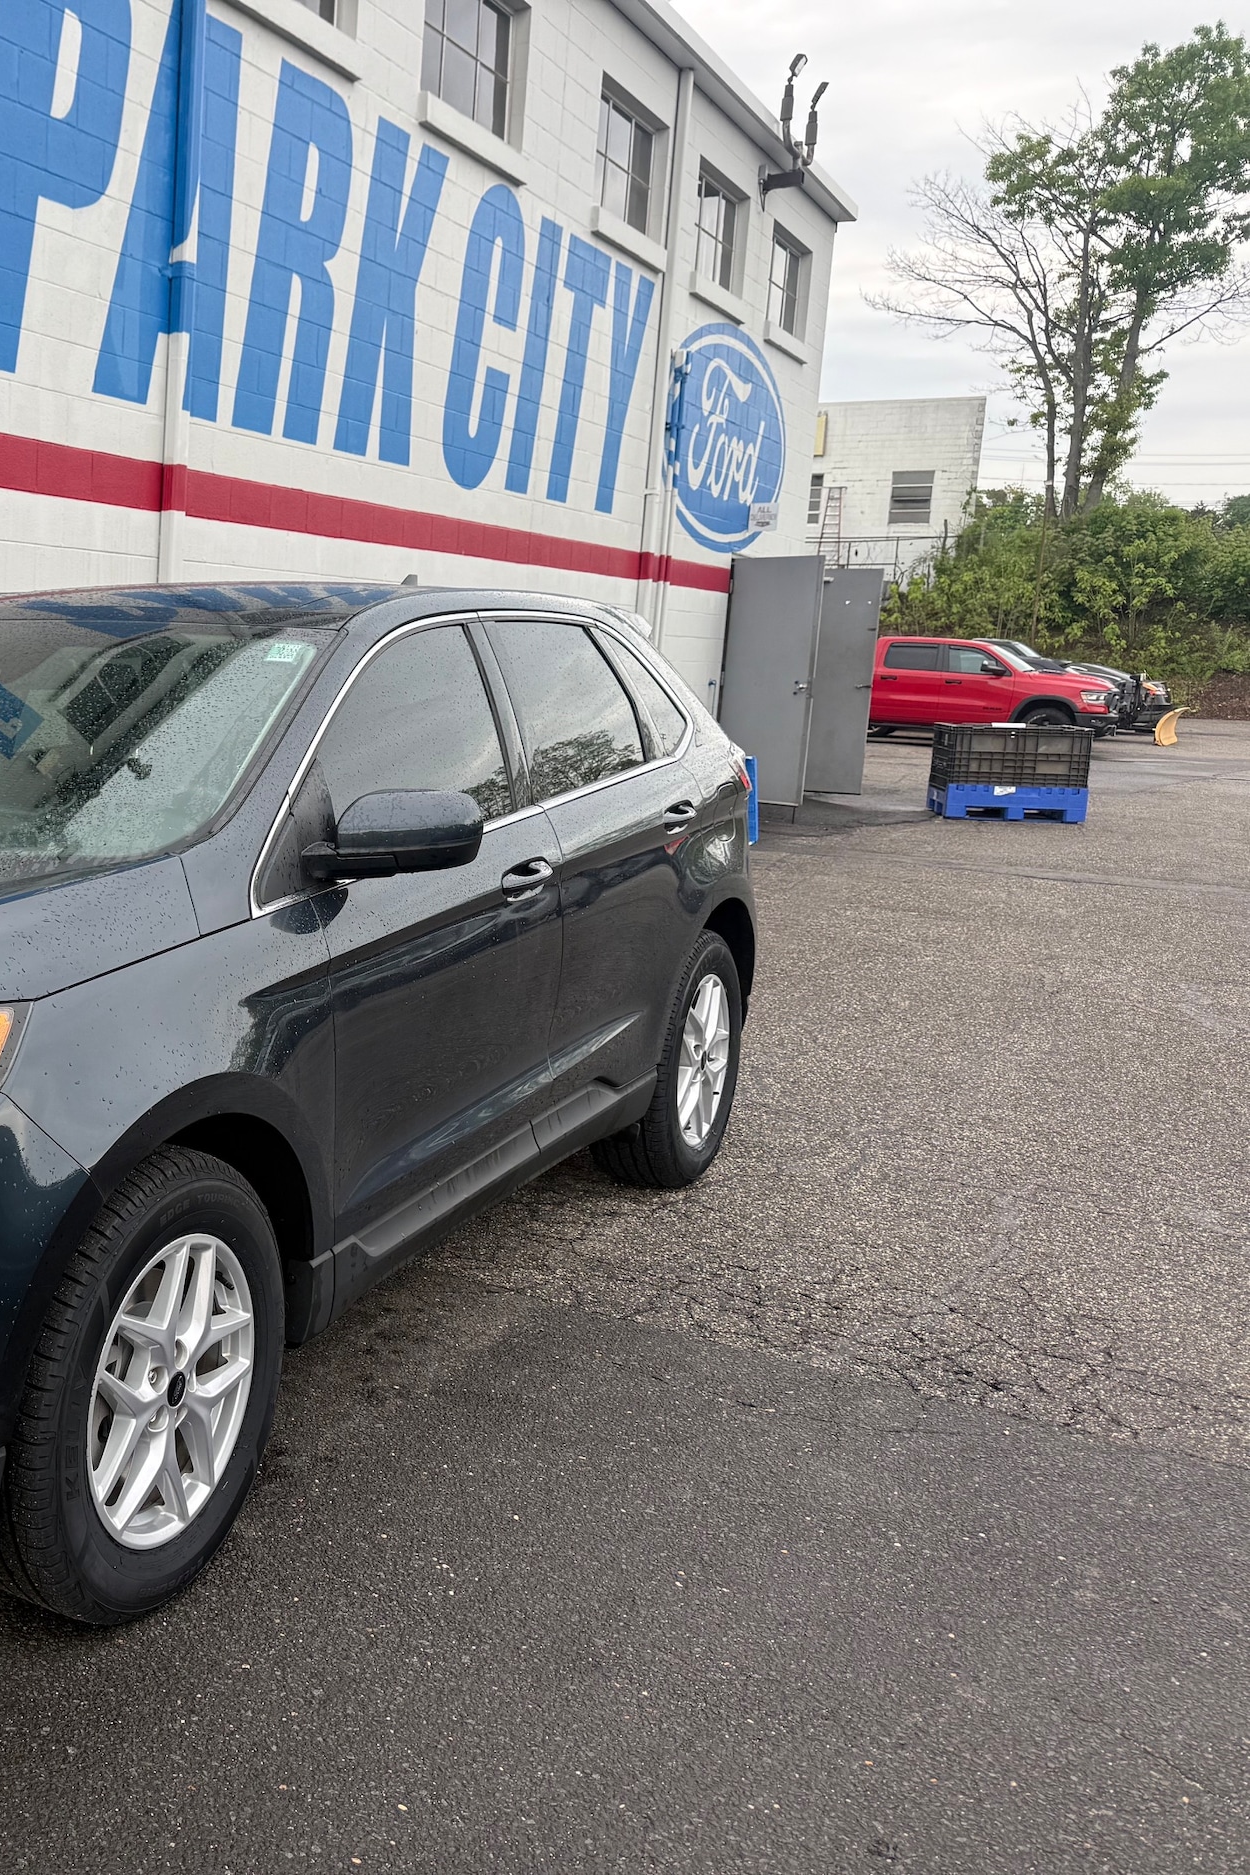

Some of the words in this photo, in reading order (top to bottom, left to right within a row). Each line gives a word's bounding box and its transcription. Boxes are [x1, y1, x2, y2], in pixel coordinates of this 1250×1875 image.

[442, 184, 654, 513] CITY
[687, 357, 766, 506] Ford
[160, 1199, 190, 1226] EDGE
